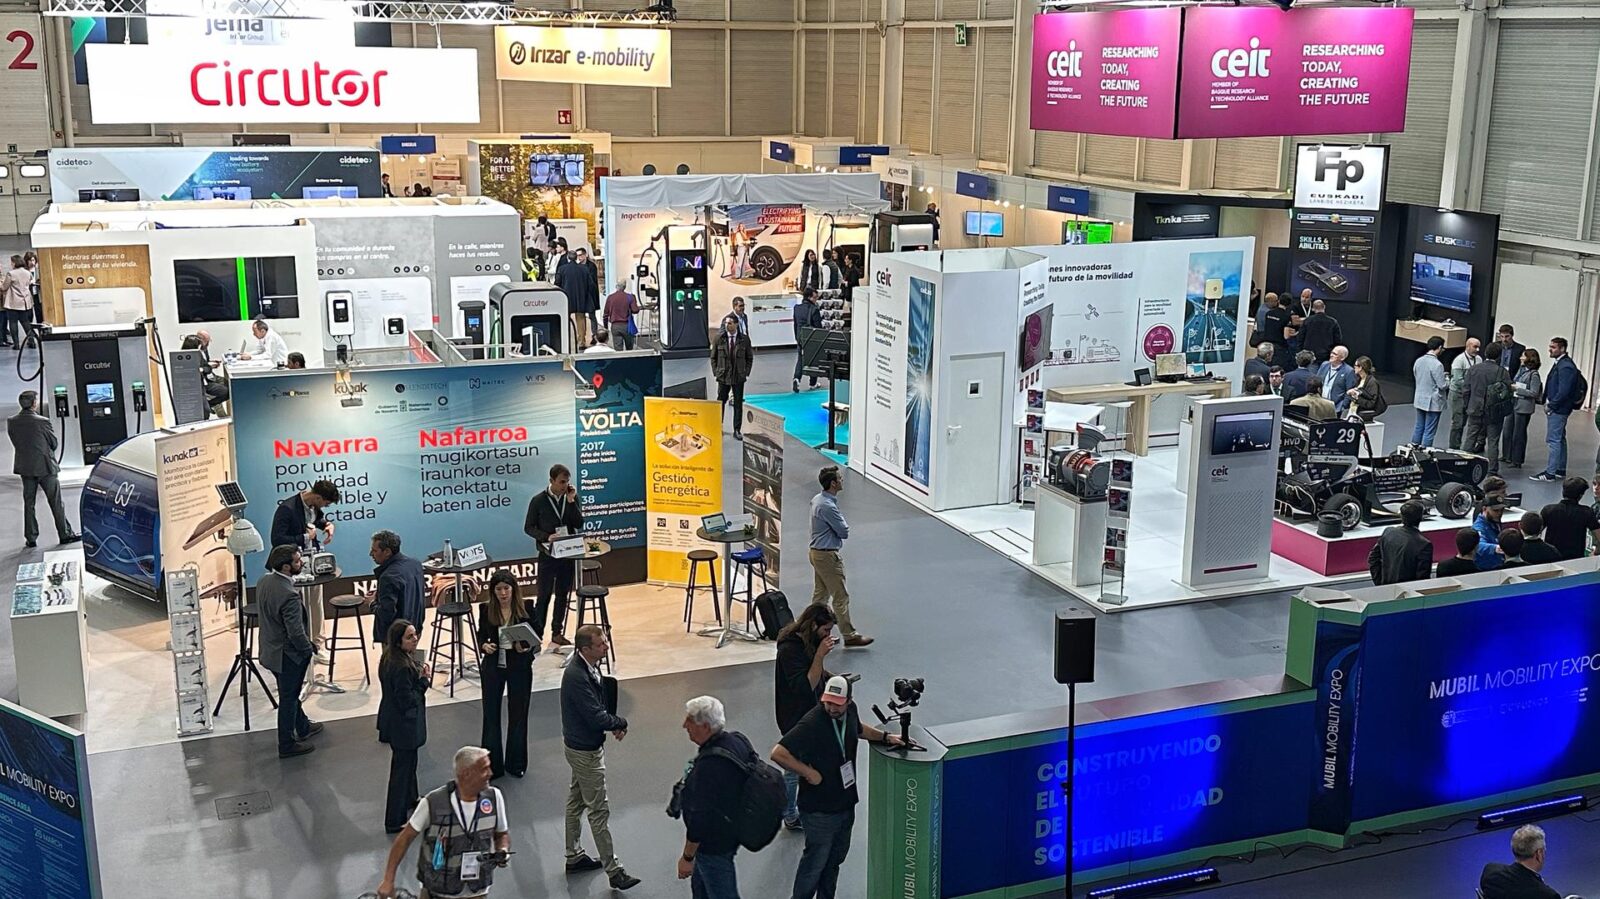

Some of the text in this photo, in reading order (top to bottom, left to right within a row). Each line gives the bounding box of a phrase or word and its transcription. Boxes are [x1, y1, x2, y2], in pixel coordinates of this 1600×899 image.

[6, 30, 38, 69] 2
[1102, 47, 1159, 58] RESEARCHING
[1211, 37, 1271, 78] ceit
[1302, 44, 1385, 56] RESEARCHING
[531, 46, 655, 72] Irizar e-mobility
[1047, 40, 1083, 78] ceit
[1102, 63, 1129, 76] TODAY,
[1302, 61, 1342, 74] TODAY,
[190, 61, 388, 107] Circutor
[1100, 79, 1140, 91] CREATING
[1300, 77, 1358, 90] CREATING
[1100, 95, 1148, 108] THE FUTURE
[1300, 93, 1370, 106] THE FUTURE
[1314, 152, 1364, 190] Fp
[621, 212, 656, 221] Ingeteam
[1064, 263, 1112, 272] innovadoras
[876, 267, 892, 287] ceit
[1048, 274, 1073, 283] futuro
[1095, 271, 1133, 280] movilidad
[580, 411, 643, 430] VOLTA
[420, 426, 528, 448] Nafarroa
[1284, 437, 1300, 446] HVD
[1336, 428, 1356, 443] 29
[273, 437, 378, 459] Navarra
[580, 441, 605, 452] 2017
[163, 450, 188, 464] kunak
[420, 446, 539, 466] mugikortasun
[275, 460, 348, 479] por una
[421, 463, 520, 481] iraunkor eta
[581, 469, 588, 478] 9
[1212, 465, 1228, 476] ceit
[652, 472, 695, 484] Gestión
[422, 480, 508, 498] konektatu
[653, 483, 710, 497] Energética
[377, 490, 387, 505] y
[423, 494, 511, 514] baten alde
[581, 495, 595, 504] 38
[583, 520, 602, 531] 10,7
[1429, 653, 1600, 699] MUBIL MOBILITY EXPO
[1323, 669, 1343, 789] MUBIL MOBILITY EXPO
[1036, 734, 1222, 782] CONSTRUYENDO
[6, 766, 75, 808] MOBILITY EXPO
[1036, 790, 1058, 811] EL
[905, 778, 918, 869] MOBILITY EXPO
[1035, 816, 1063, 838] DE
